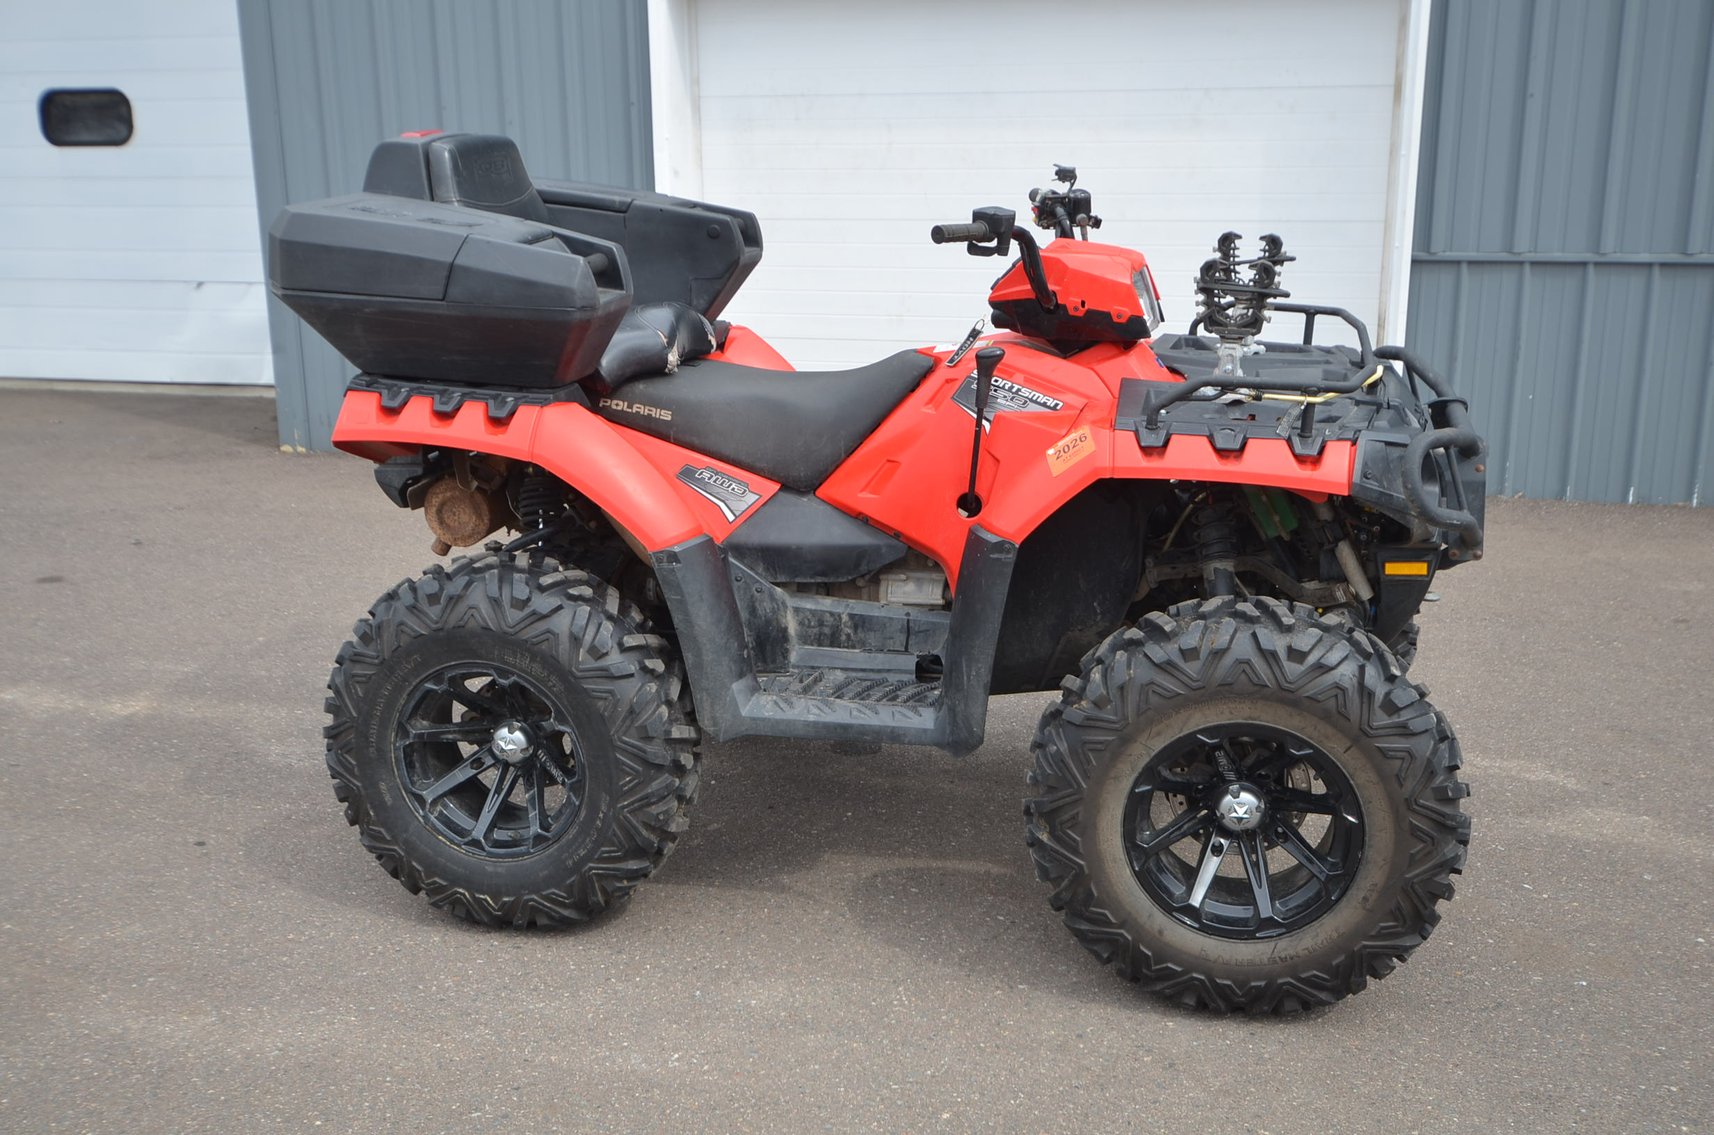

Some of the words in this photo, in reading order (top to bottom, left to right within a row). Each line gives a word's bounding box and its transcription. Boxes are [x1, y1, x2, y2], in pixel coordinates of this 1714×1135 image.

[971, 369, 1064, 409] SORTSMAN
[599, 398, 672, 421] POLARIS
[1055, 432, 1088, 461] 2026
[695, 468, 750, 497] AWD
